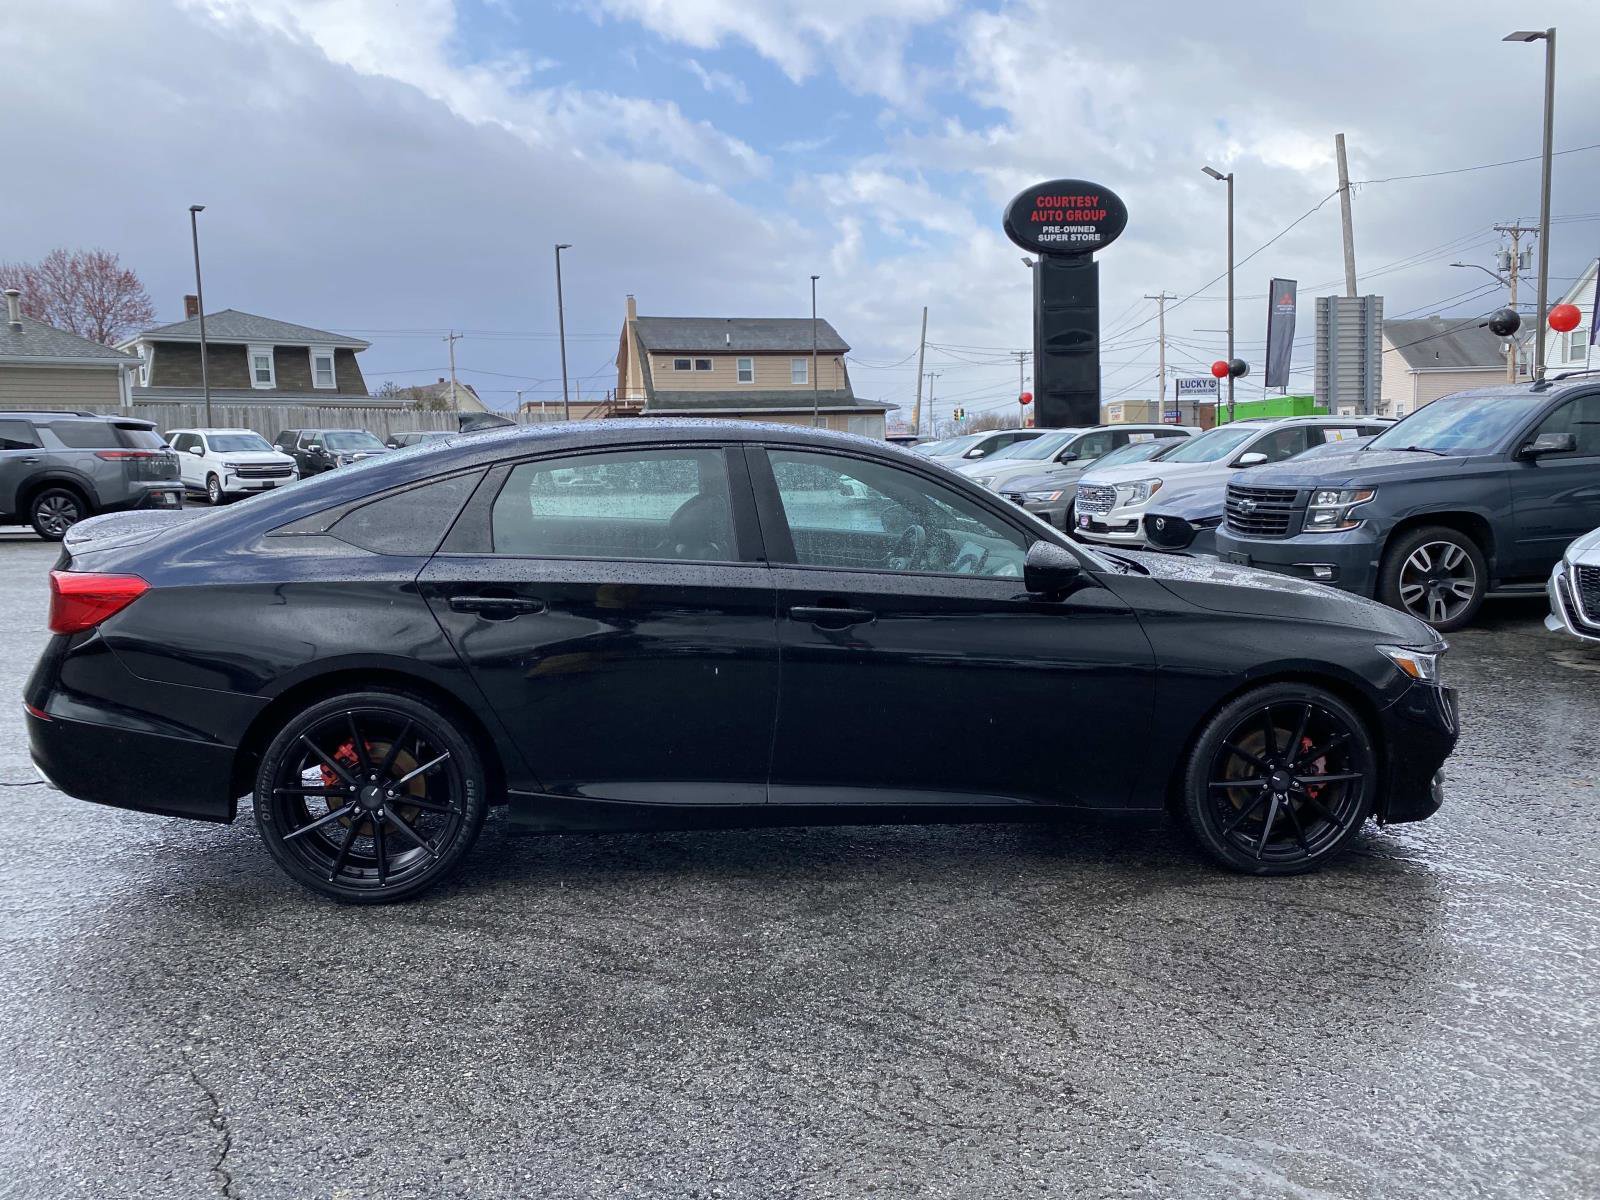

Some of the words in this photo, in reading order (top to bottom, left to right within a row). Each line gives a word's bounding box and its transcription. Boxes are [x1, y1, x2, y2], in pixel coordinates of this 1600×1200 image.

[1036, 195, 1099, 208] COURTESY
[1031, 210, 1063, 222] AUTO
[1066, 209, 1107, 221] GROUP
[1042, 225, 1096, 233] PRE-OWNED
[1038, 233, 1068, 241] SUPER
[1070, 233, 1101, 241] STORE
[1180, 379, 1208, 389] LUCKY
